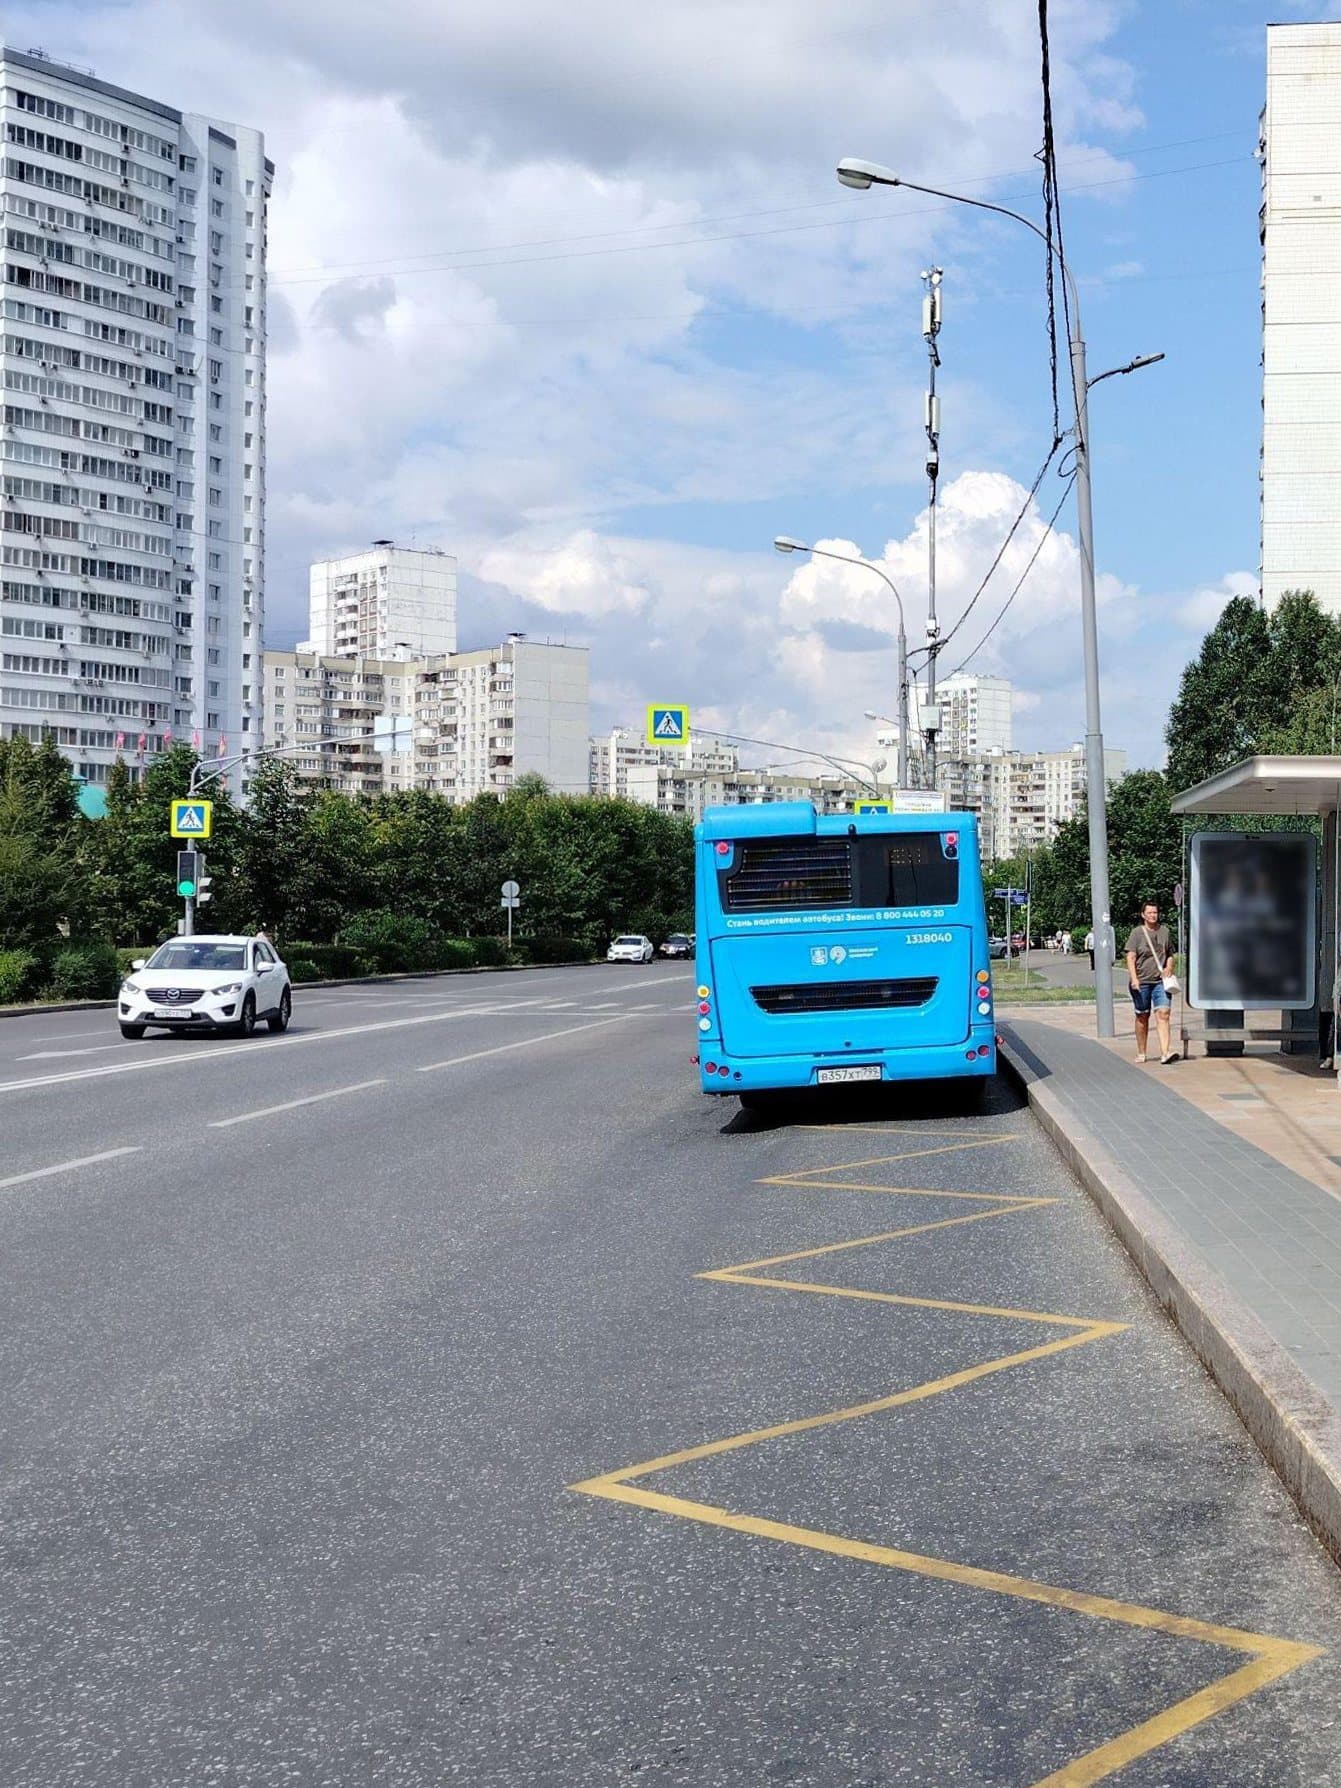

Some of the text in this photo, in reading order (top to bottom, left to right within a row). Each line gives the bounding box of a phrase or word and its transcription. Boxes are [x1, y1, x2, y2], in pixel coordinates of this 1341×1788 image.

[727, 919, 752, 928] Стань
[754, 917, 801, 927] водителем
[803, 913, 843, 924] автобуса!
